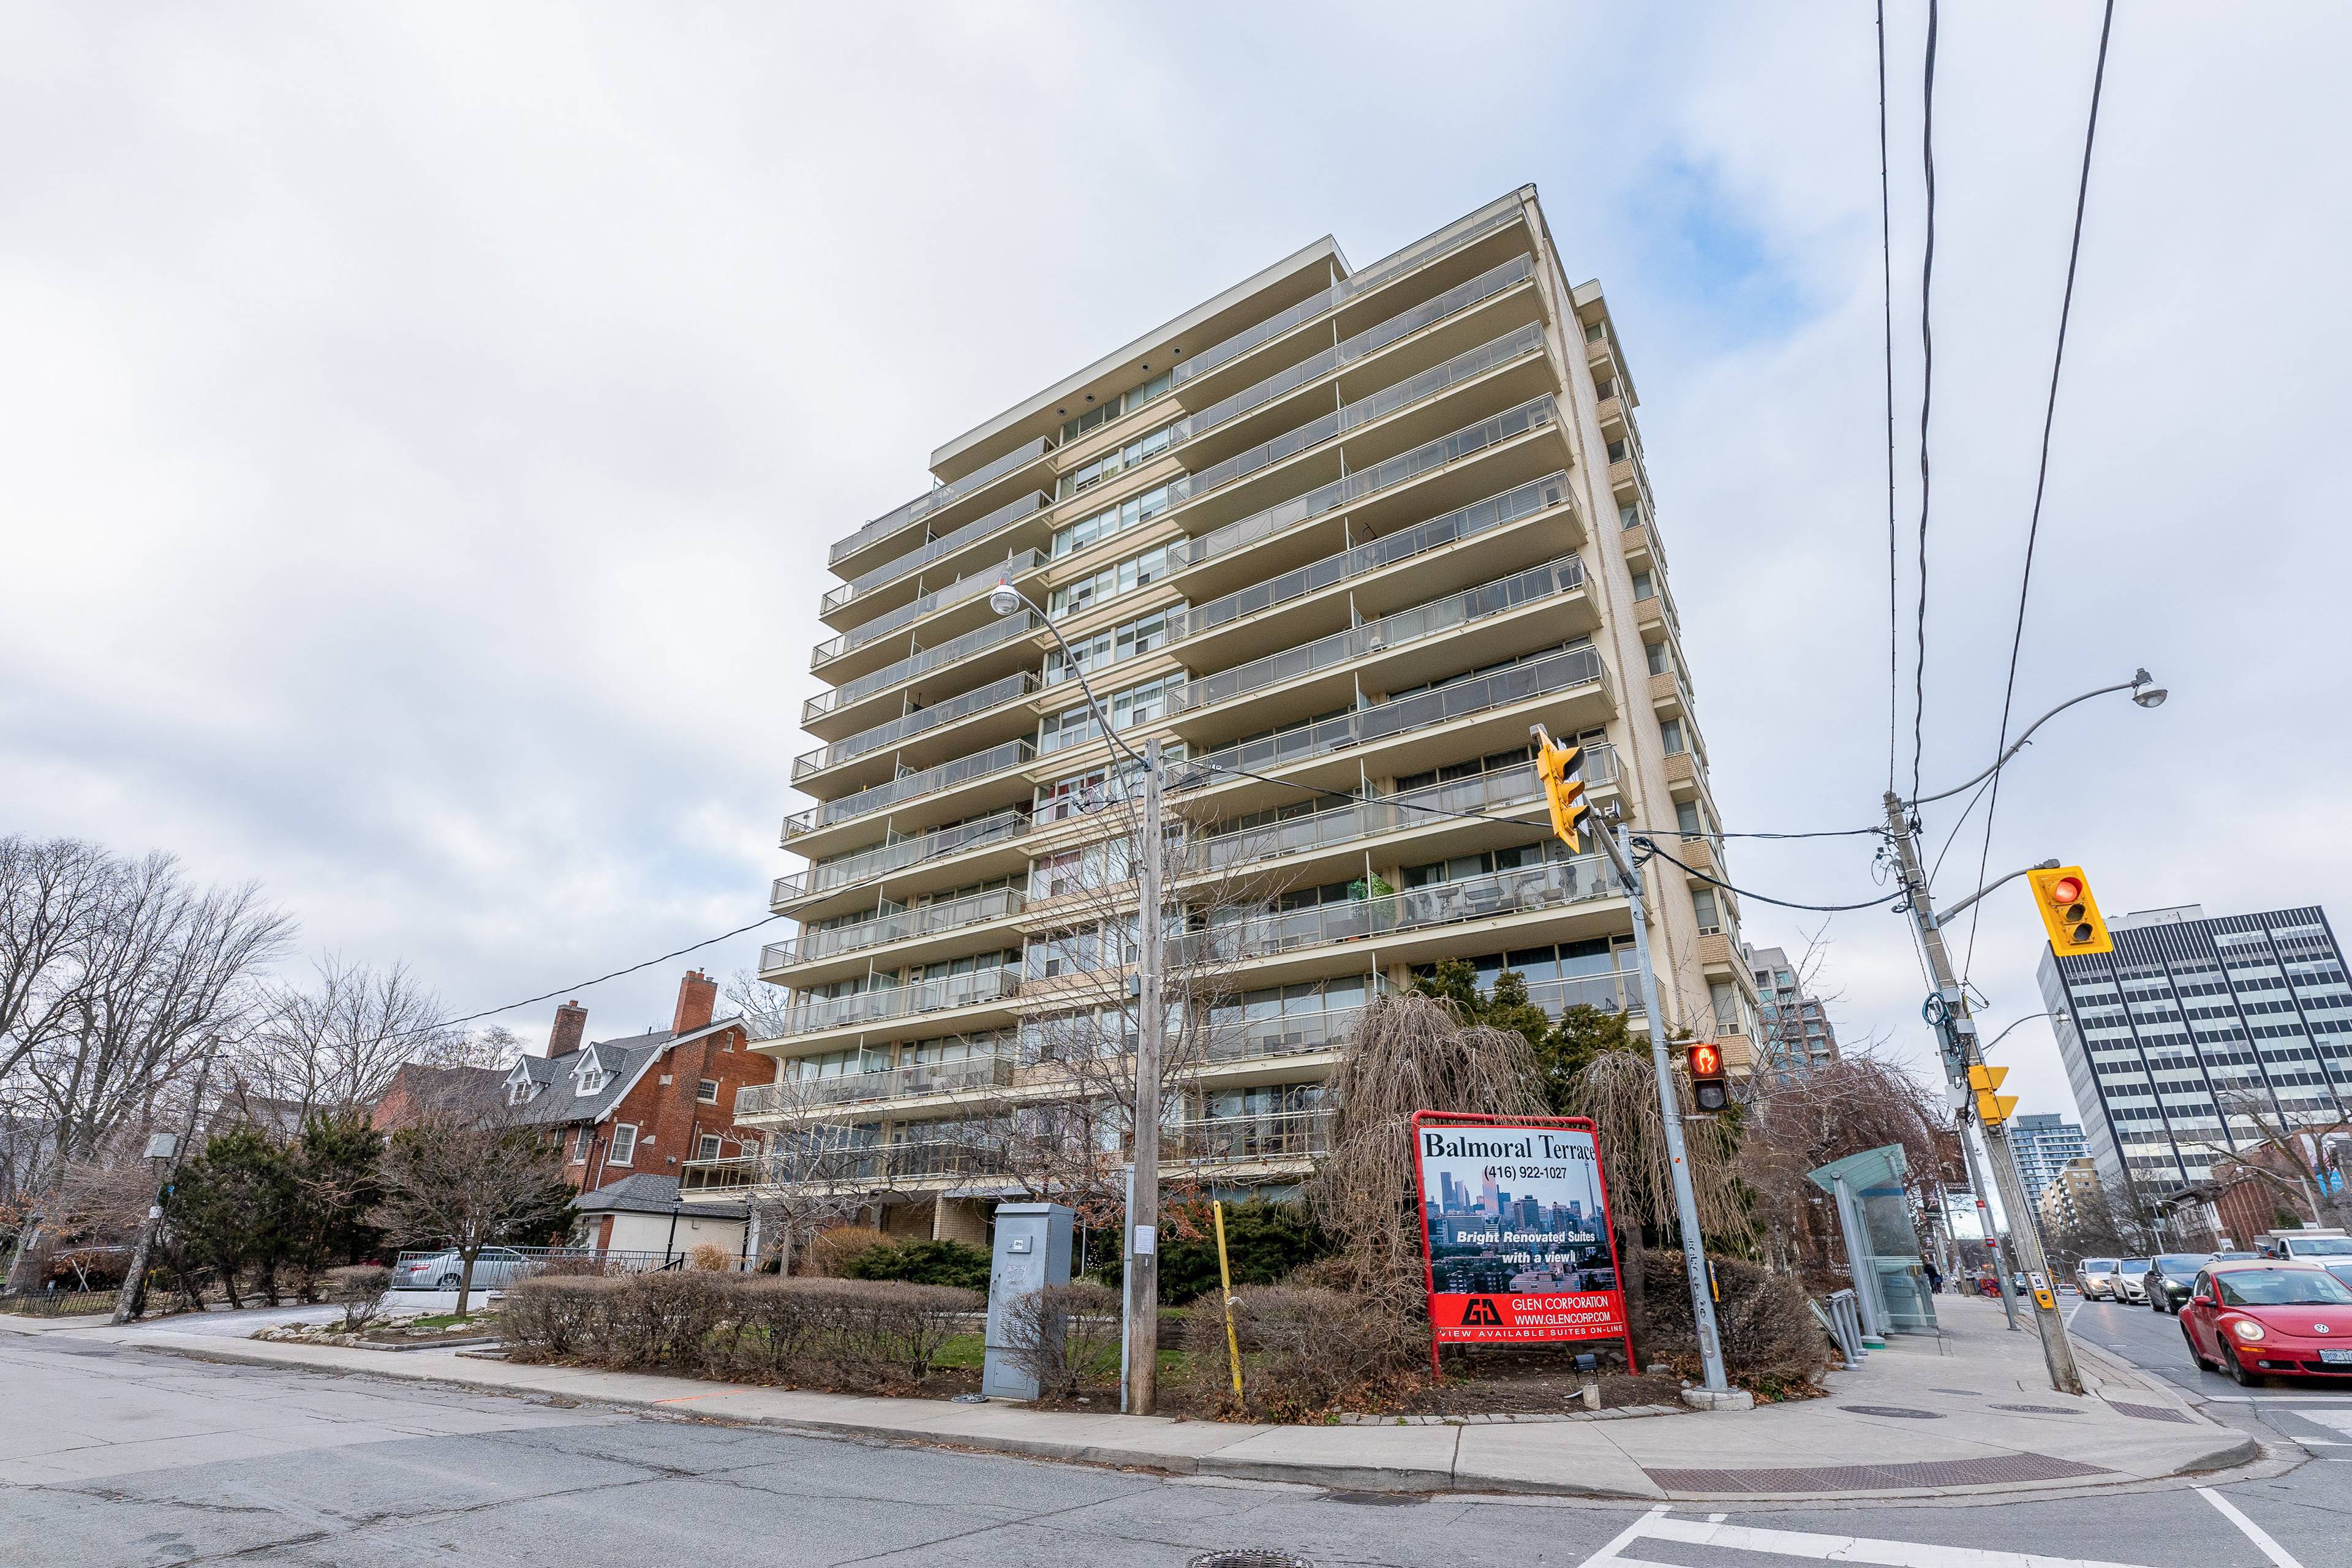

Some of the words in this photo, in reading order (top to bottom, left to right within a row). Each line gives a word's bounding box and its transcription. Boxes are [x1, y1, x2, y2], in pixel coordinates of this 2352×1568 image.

[1423, 1133, 1533, 1158] Balmoral
[1539, 1135, 1596, 1161] Terrace
[1484, 1166, 1517, 1182] (416)
[1520, 1166, 1567, 1179] 922-1027
[1457, 1231, 1499, 1245] Bright
[1503, 1231, 1565, 1243] Renovated
[1568, 1231, 1596, 1242] Suites
[1502, 1251, 1530, 1264] with
[1534, 1254, 1542, 1263] a
[1512, 1298, 1542, 1311] GLEN
[1545, 1295, 1608, 1310] CORPORATION
[1514, 1311, 1611, 1325] WWW.GLENCORP.COM
[1550, 1327, 1586, 1336] SUITES
[1590, 1325, 1624, 1334] ON-LINE
